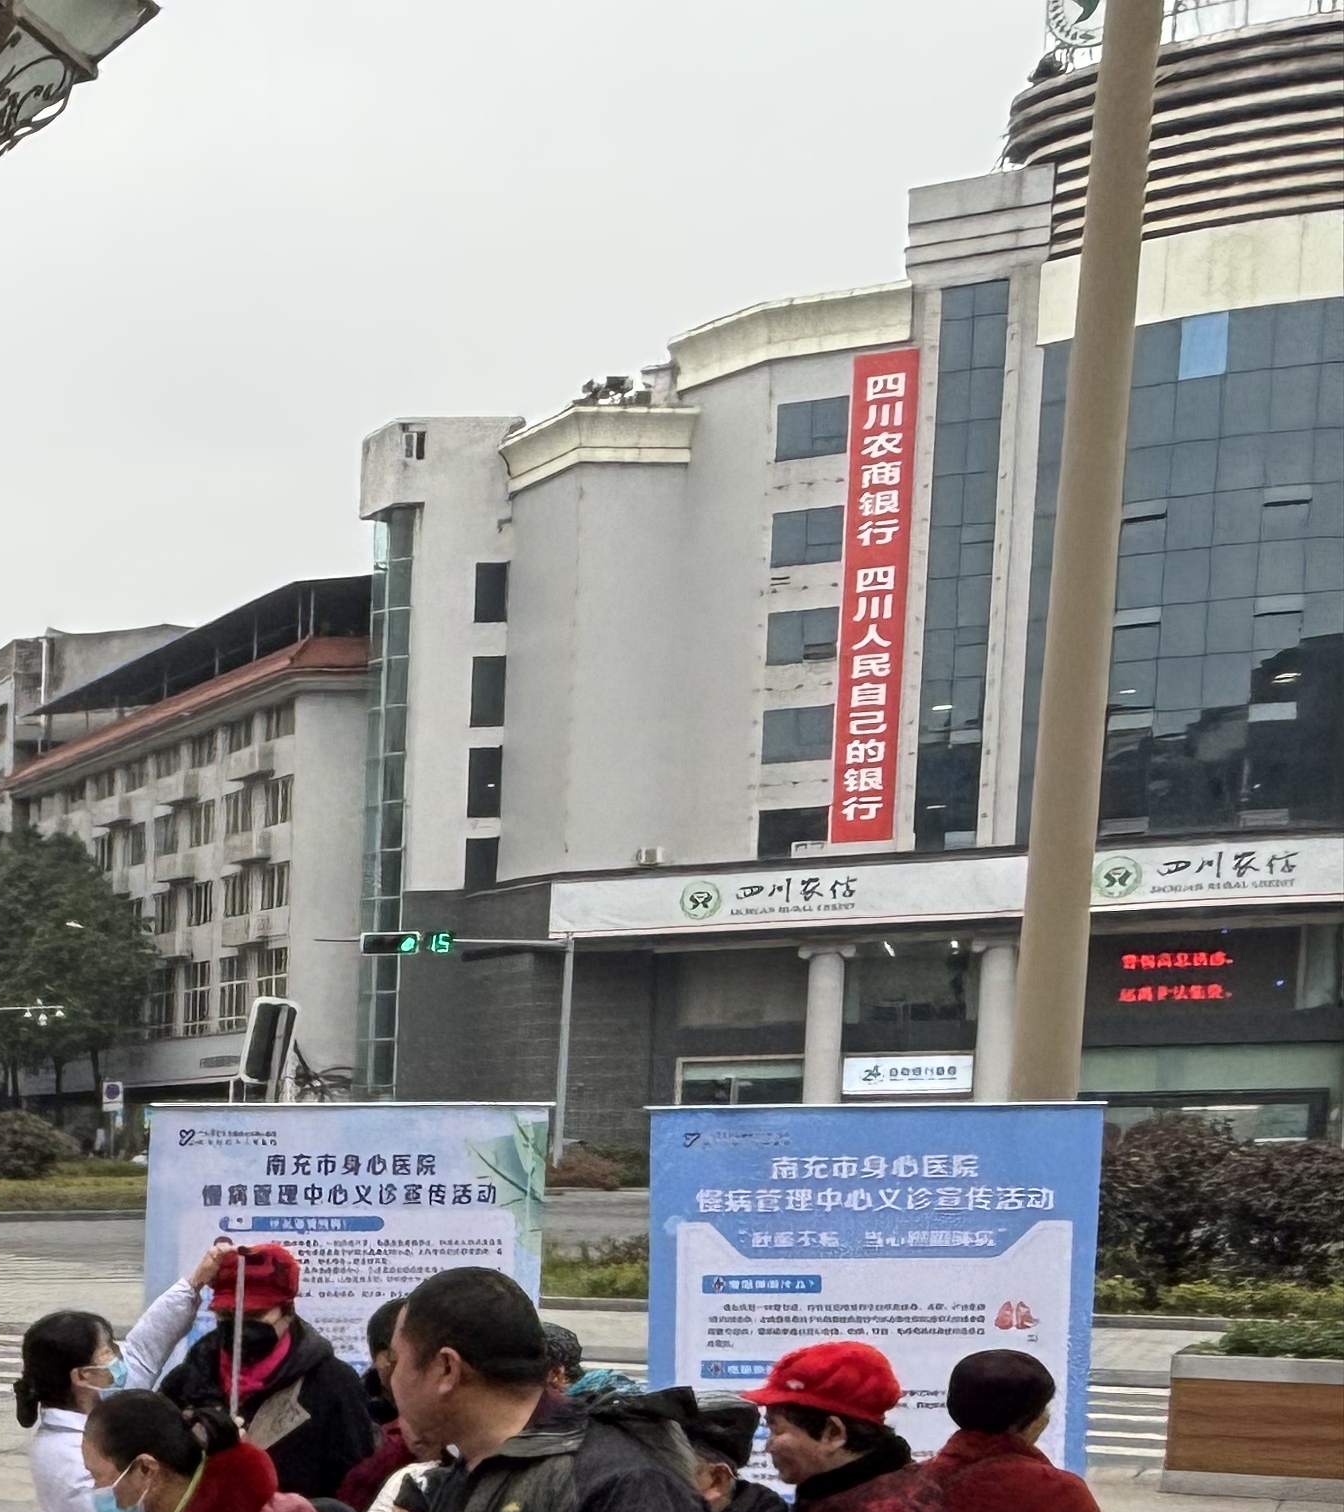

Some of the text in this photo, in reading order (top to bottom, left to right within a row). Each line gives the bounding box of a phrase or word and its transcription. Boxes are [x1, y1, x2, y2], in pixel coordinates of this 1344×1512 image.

[841, 371, 906, 822] 四川农商银行 四川人民自己的银行
[430, 933, 450, 953] 15
[265, 1153, 437, 1177] 南充市身心医院
[771, 1154, 980, 1180] 南充市身心医院
[201, 1183, 498, 1207] 慢病管理中心义诊宣传活动
[695, 1187, 1055, 1214] 慢病管理中心义诊宣传活动
